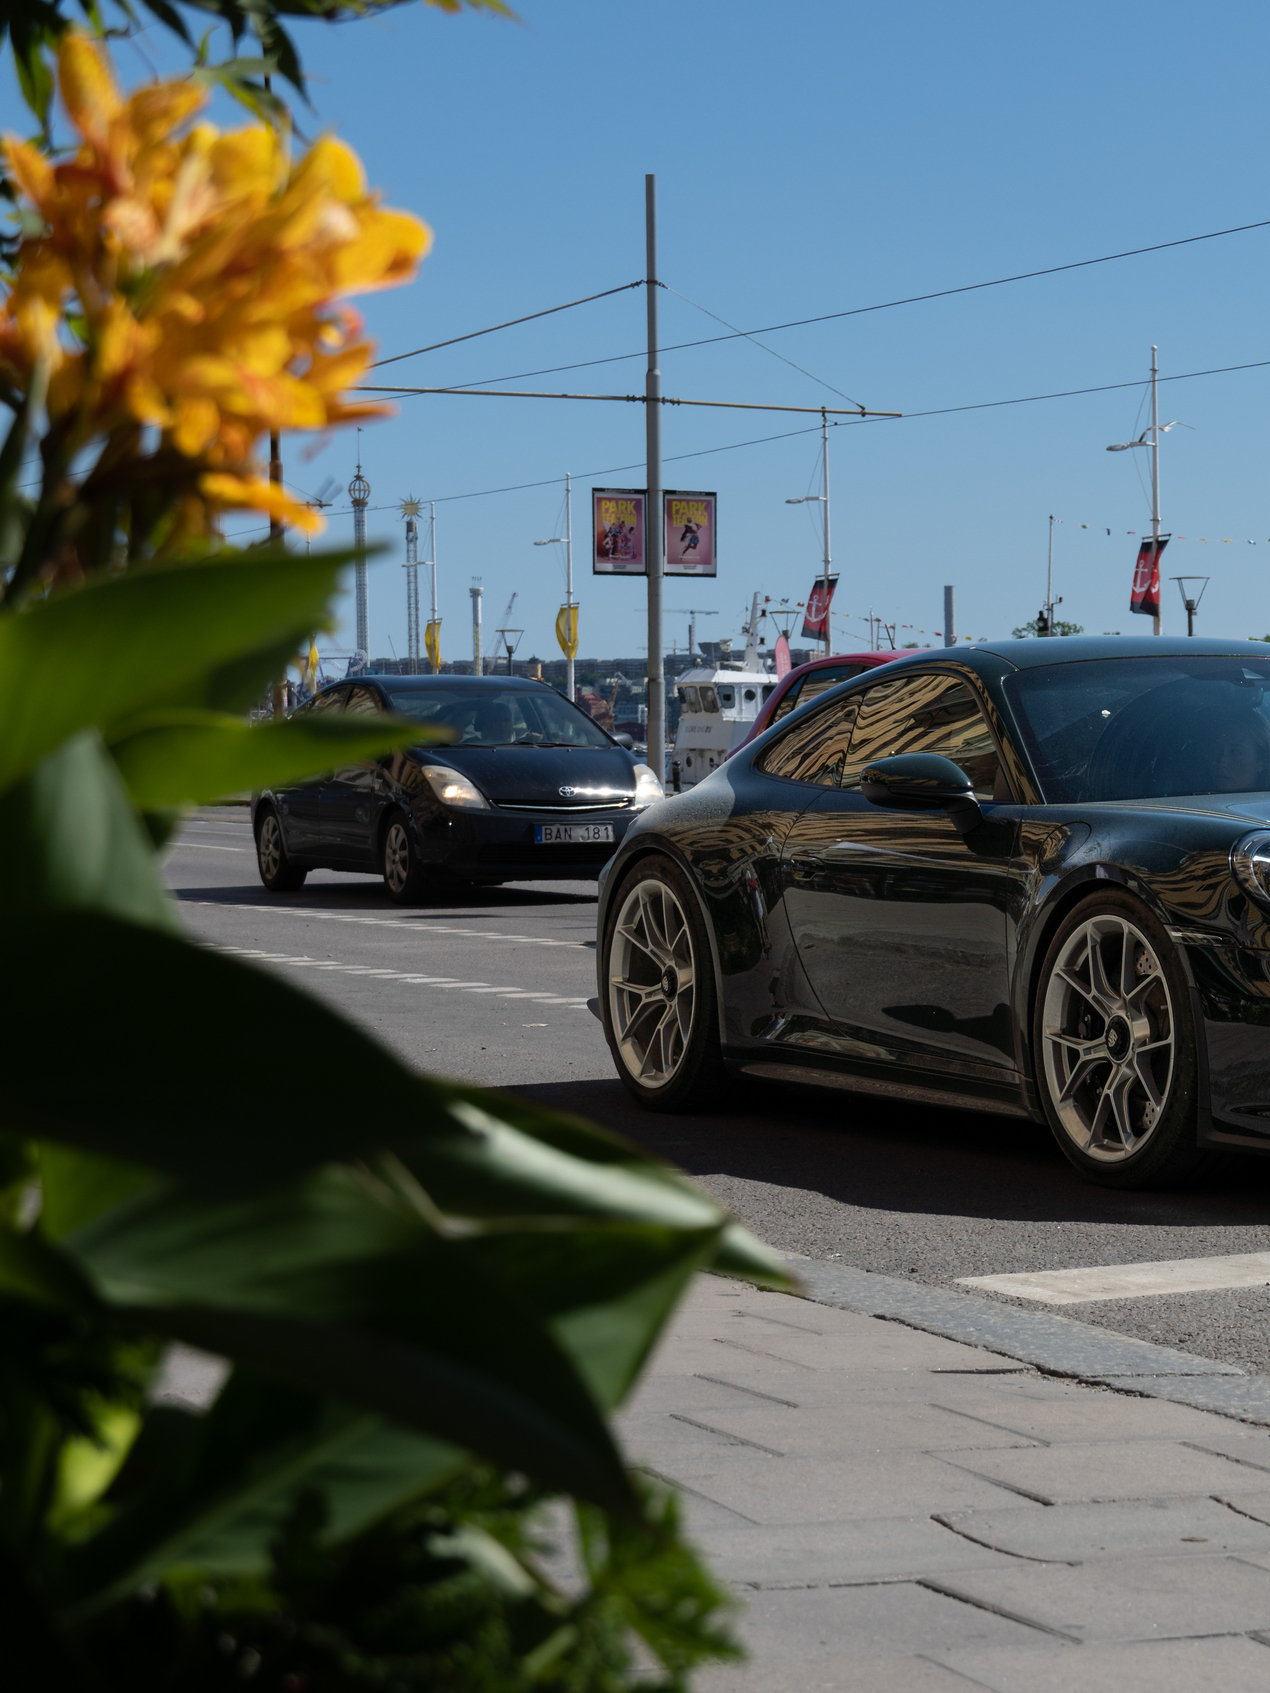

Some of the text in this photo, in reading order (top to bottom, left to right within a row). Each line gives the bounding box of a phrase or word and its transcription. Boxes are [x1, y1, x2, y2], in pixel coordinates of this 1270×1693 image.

[601, 500, 637, 514] PARK
[672, 501, 707, 515] PARK
[544, 826, 610, 841] BAN 181
